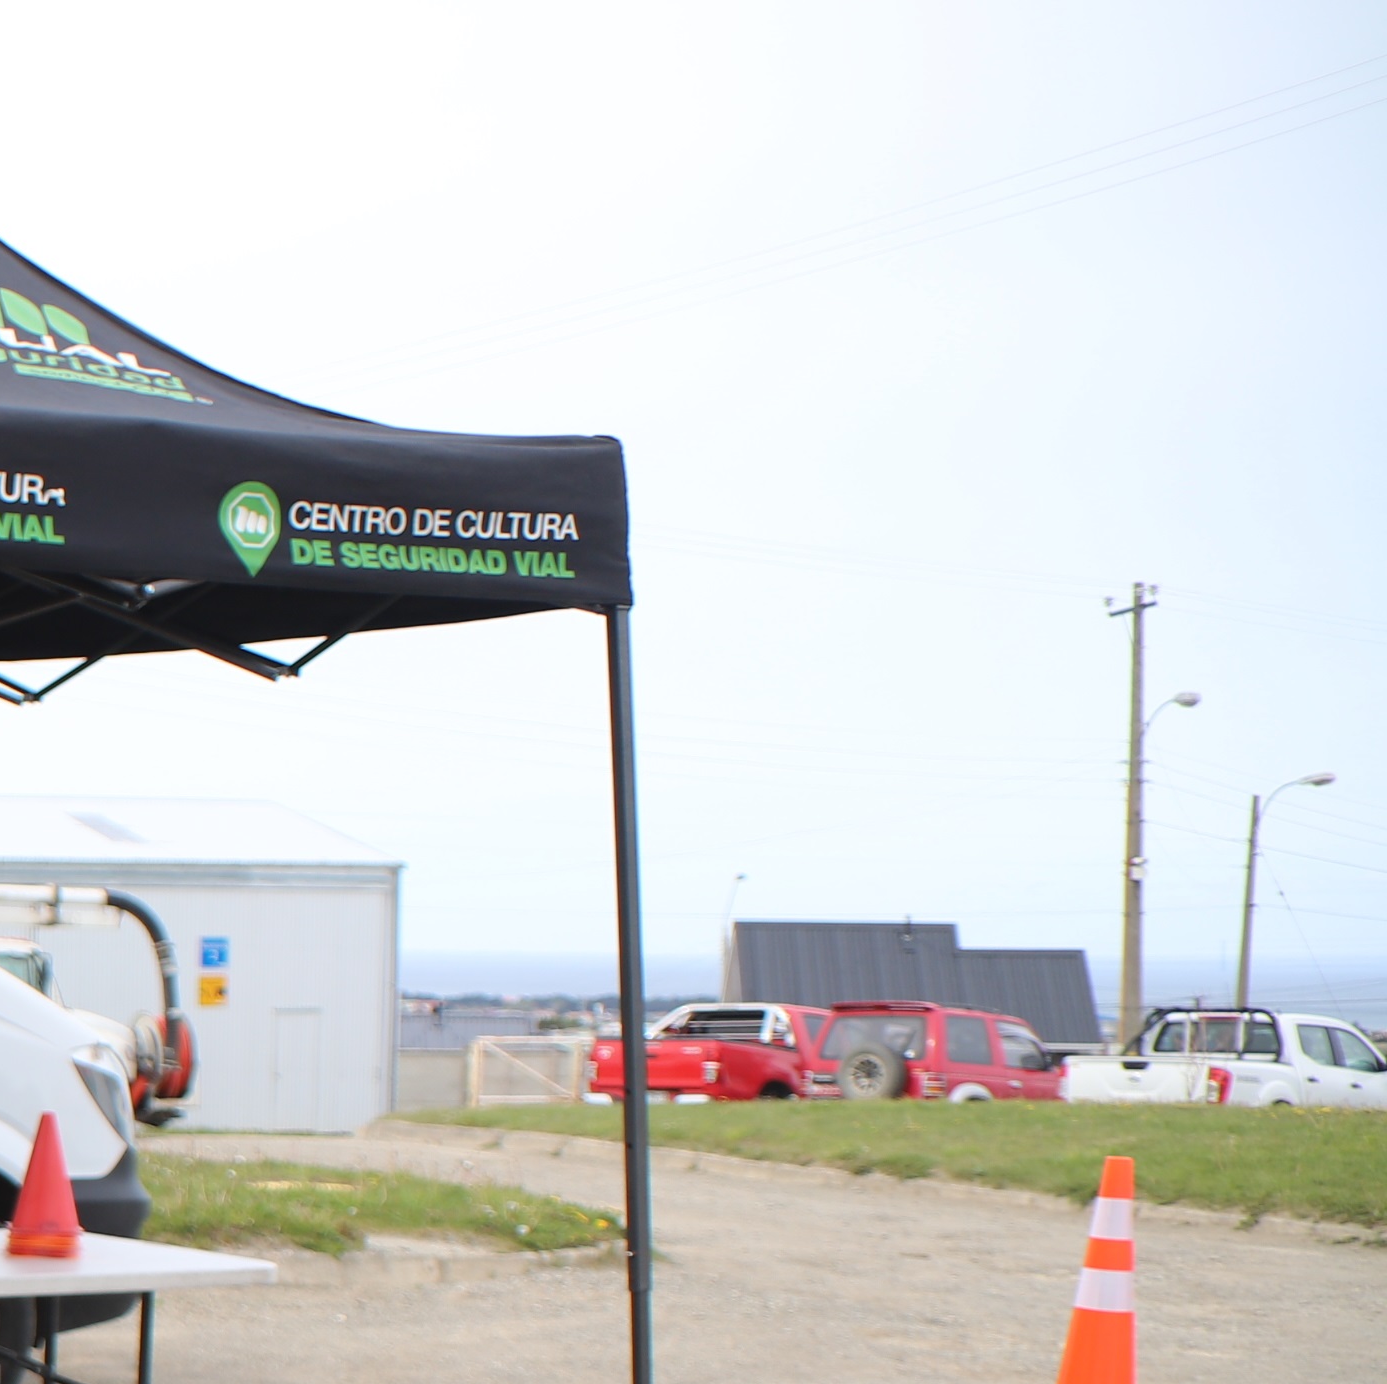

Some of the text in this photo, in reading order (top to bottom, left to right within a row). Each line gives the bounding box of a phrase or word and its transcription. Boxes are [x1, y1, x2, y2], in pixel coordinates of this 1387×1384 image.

[287, 500, 580, 542] CENTRO DE CULTURA
[289, 538, 577, 580] DE SEGURIDAD VIAL
